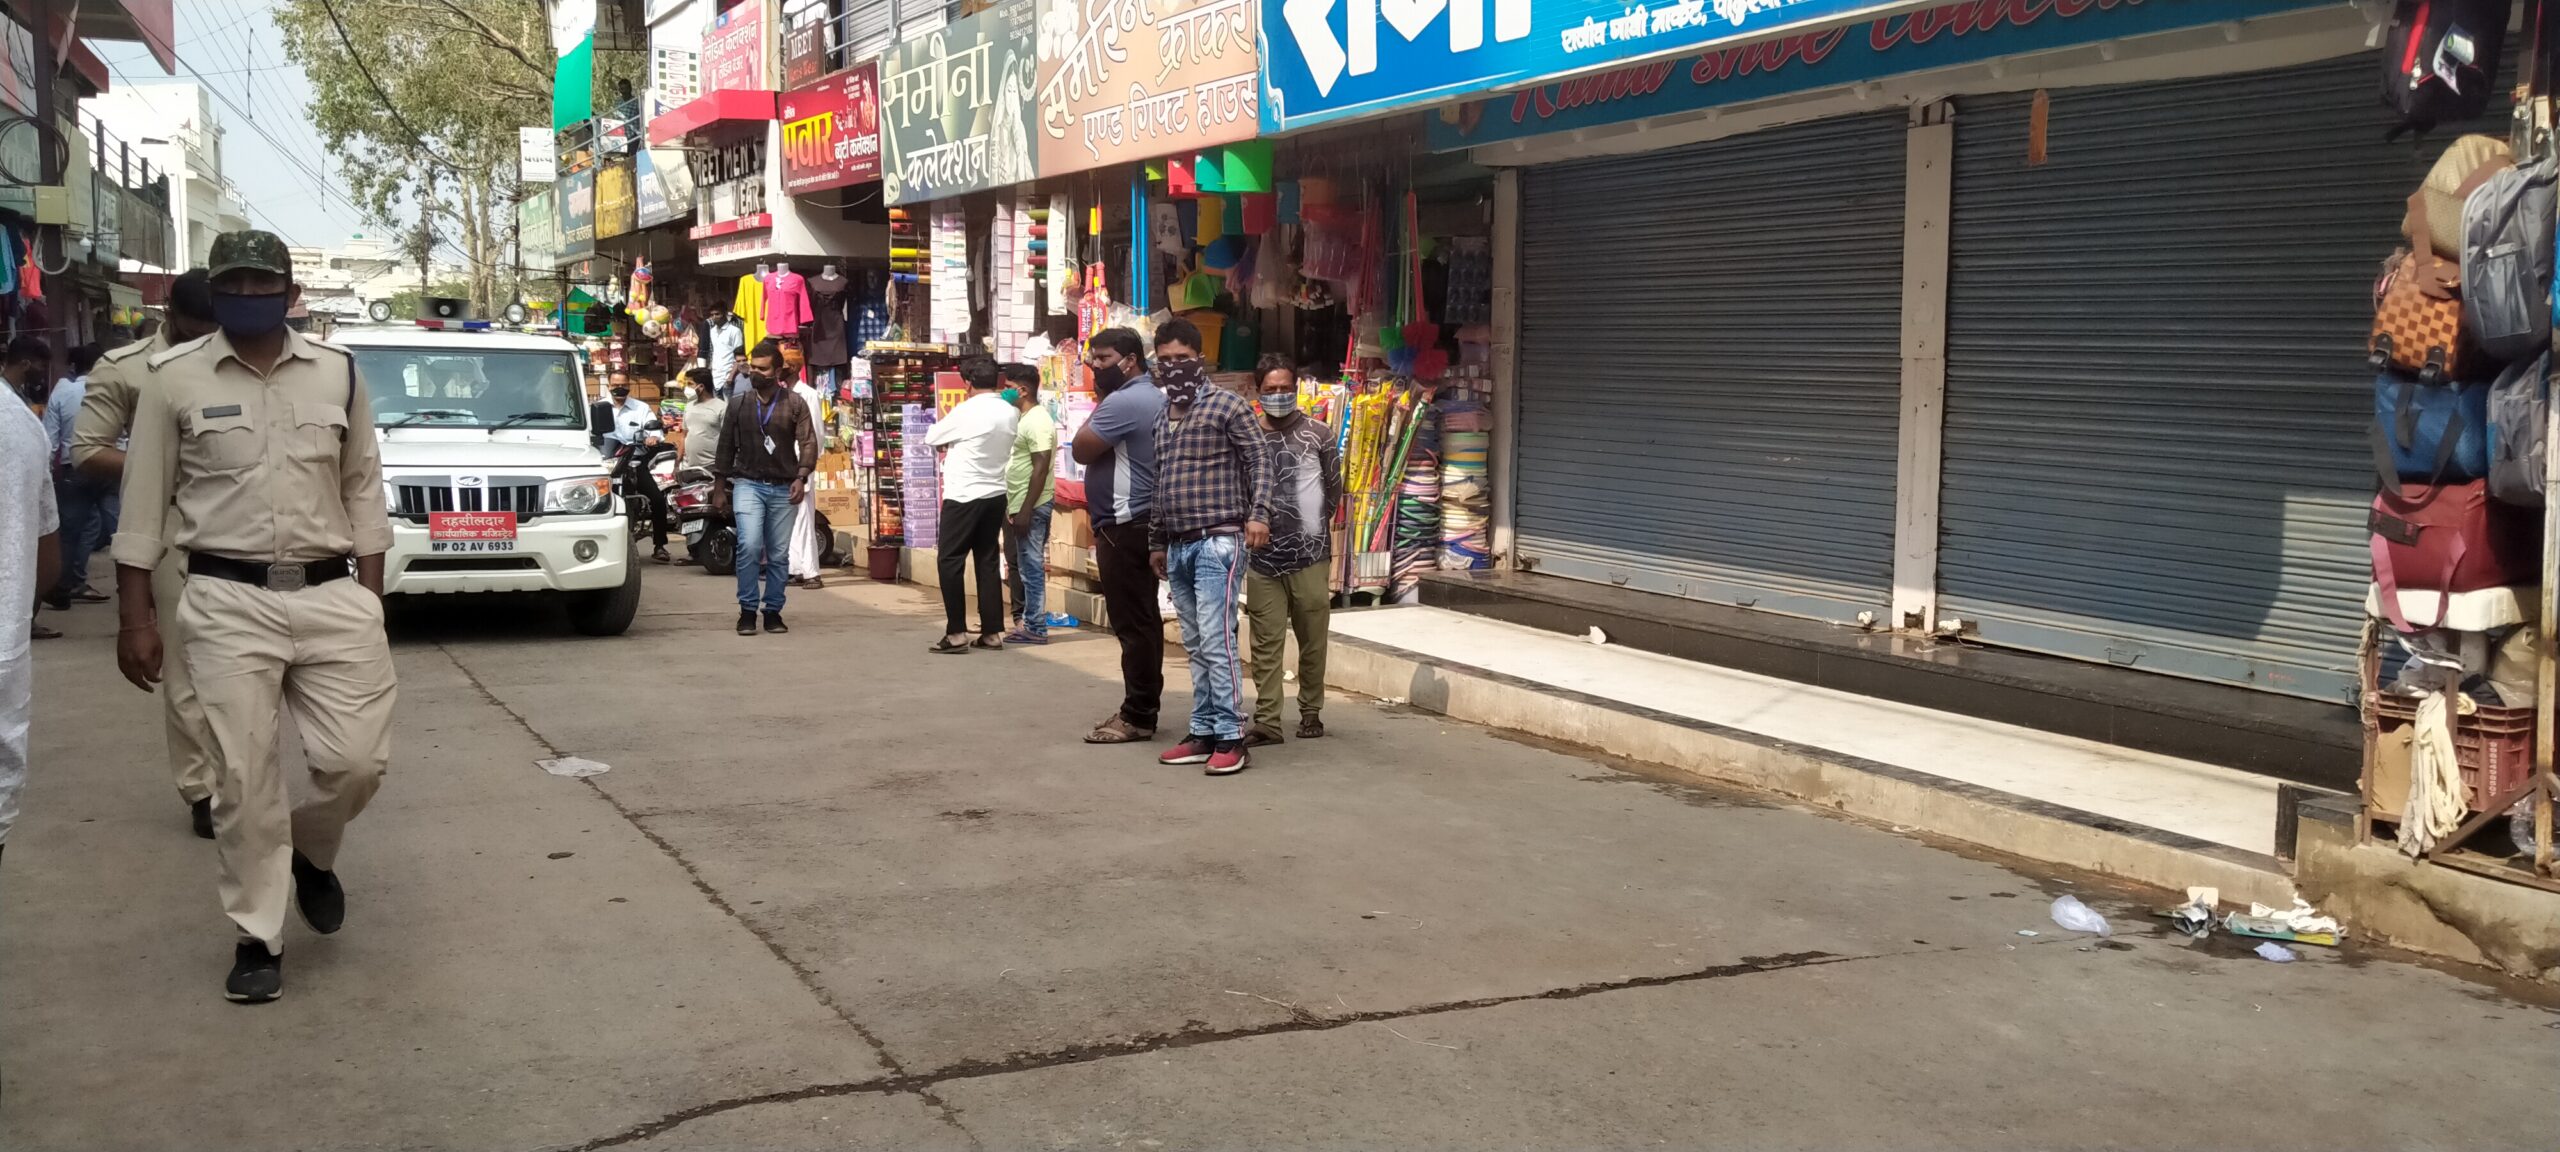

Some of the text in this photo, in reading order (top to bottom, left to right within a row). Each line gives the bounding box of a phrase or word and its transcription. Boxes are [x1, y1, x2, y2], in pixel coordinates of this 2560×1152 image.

[725, 20, 758, 53] कलेक्शन
[790, 29, 814, 61] MEET
[881, 32, 993, 180] समीना
[1082, 71, 1257, 161] एण्ड गिफ्ट हाउस
[783, 111, 835, 171] पवार
[849, 132, 878, 158] कलेक्शन
[906, 128, 989, 192] कलेक्शन
[731, 178, 760, 218] WEAR
[440, 513, 505, 527] तहसीलदार
[432, 542, 448, 552] MP
[469, 542, 485, 552] AV
[488, 541, 514, 551] 6933
